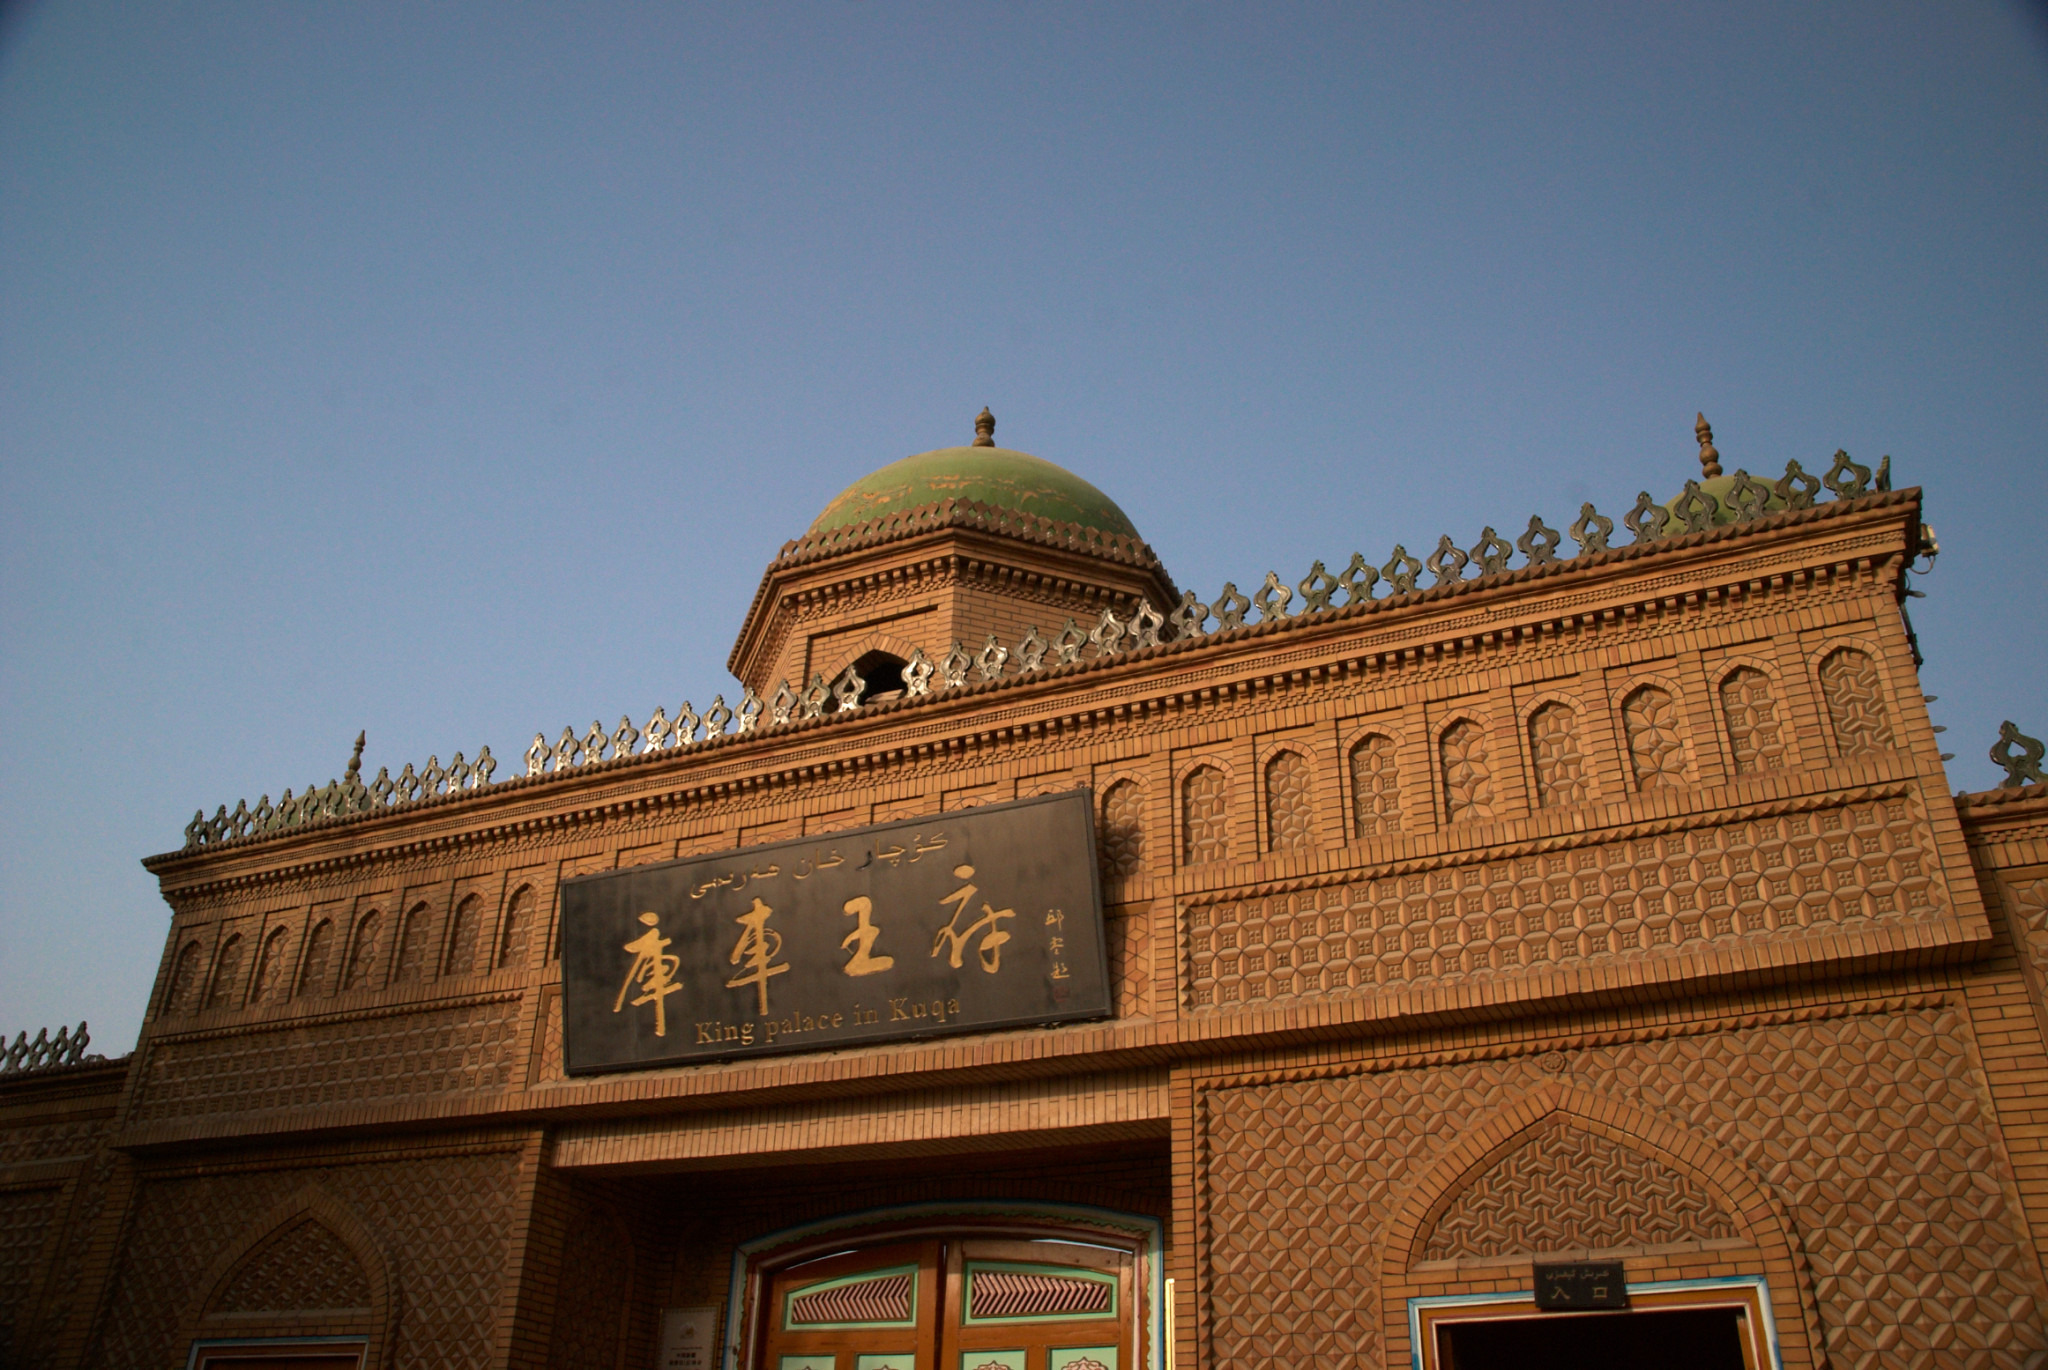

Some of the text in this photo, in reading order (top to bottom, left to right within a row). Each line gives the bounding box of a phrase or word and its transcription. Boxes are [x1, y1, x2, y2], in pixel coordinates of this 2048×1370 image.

[792, 848, 846, 880] خان
[695, 997, 961, 1045] King palace in Kuqa
[1551, 1286, 1609, 1300] 入口
